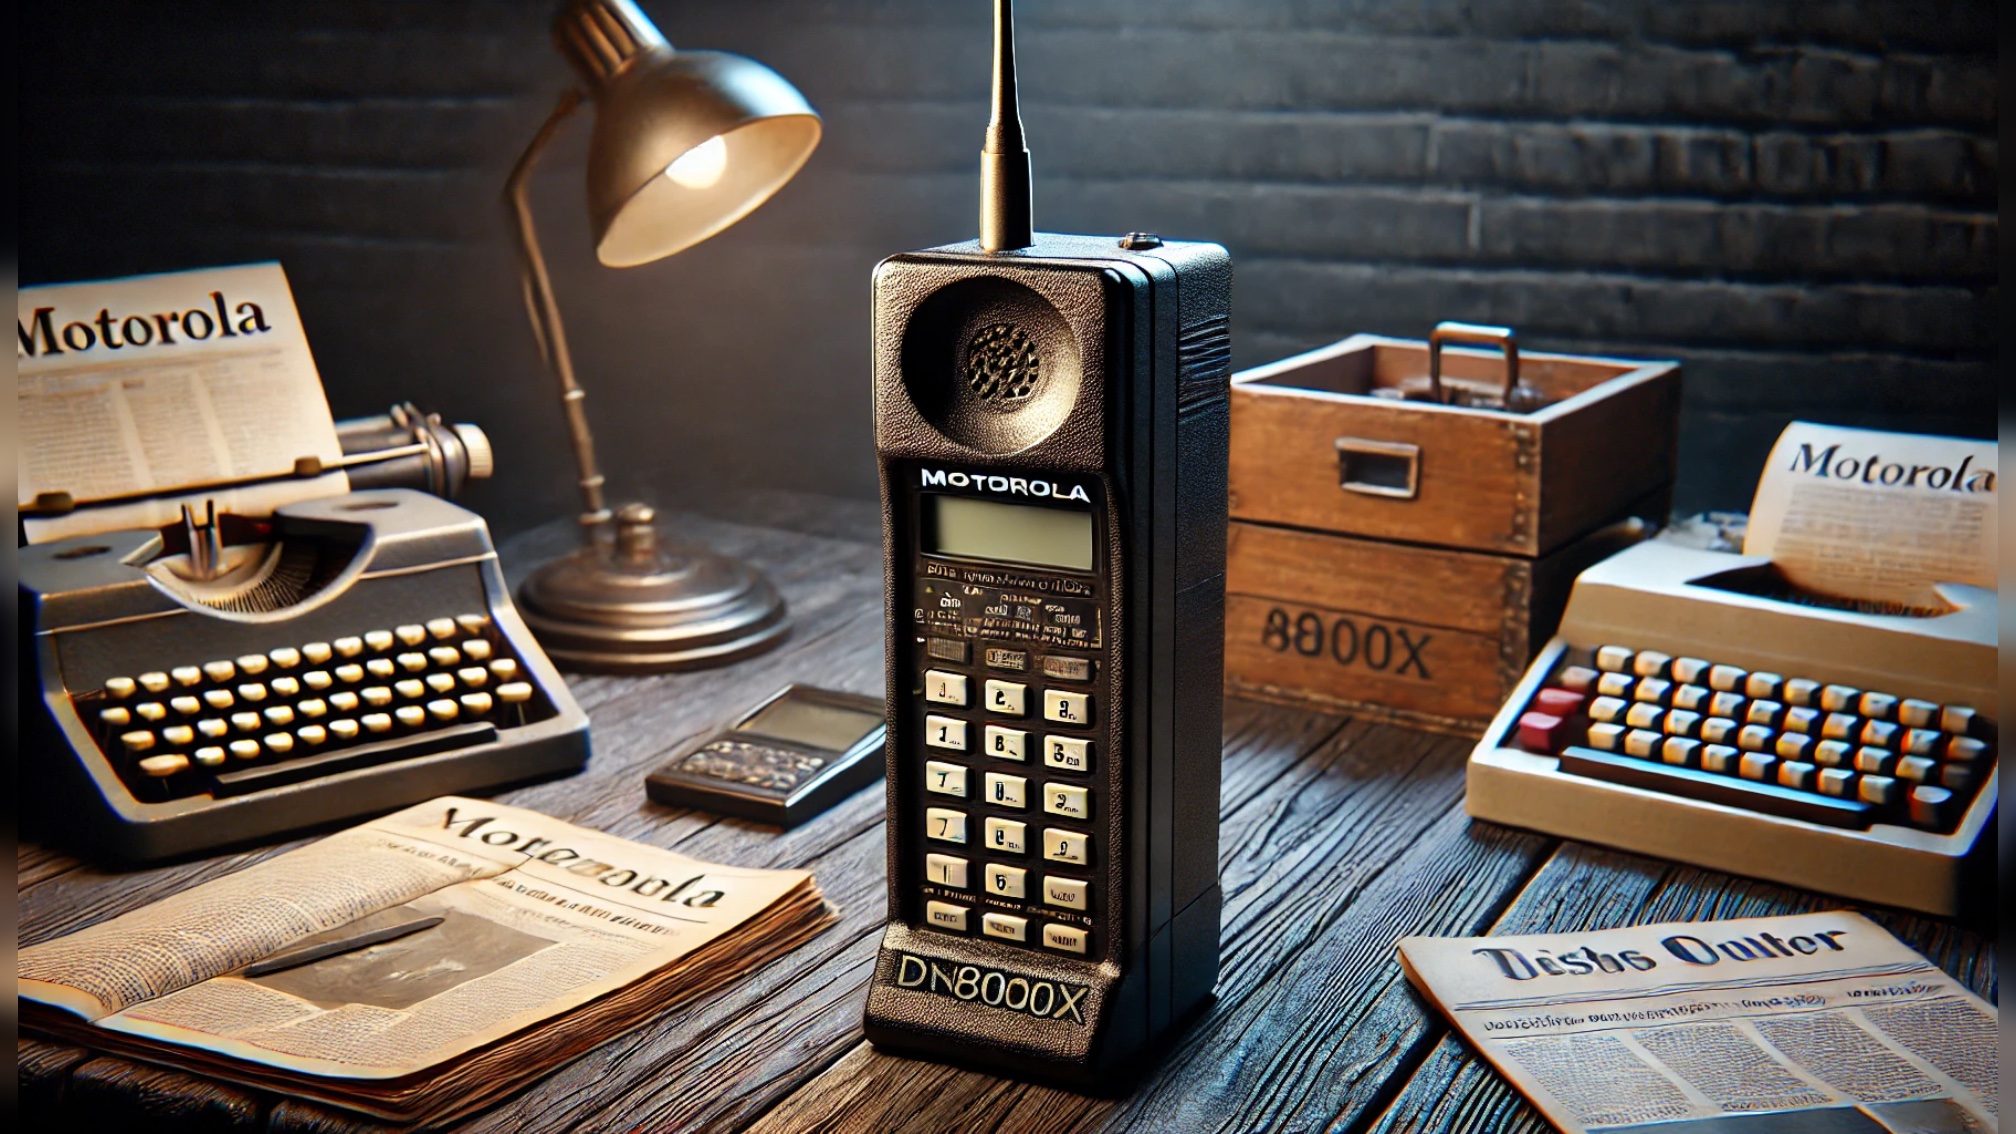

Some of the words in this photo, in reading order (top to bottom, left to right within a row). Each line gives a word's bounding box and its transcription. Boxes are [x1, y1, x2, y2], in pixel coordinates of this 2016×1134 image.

[18, 291, 271, 358] Motorola
[921, 468, 1091, 503] MOTOROLA
[1788, 442, 1997, 493] Motorola
[1262, 608, 1433, 680] 8800X
[897, 955, 1088, 1024] DN8000X
